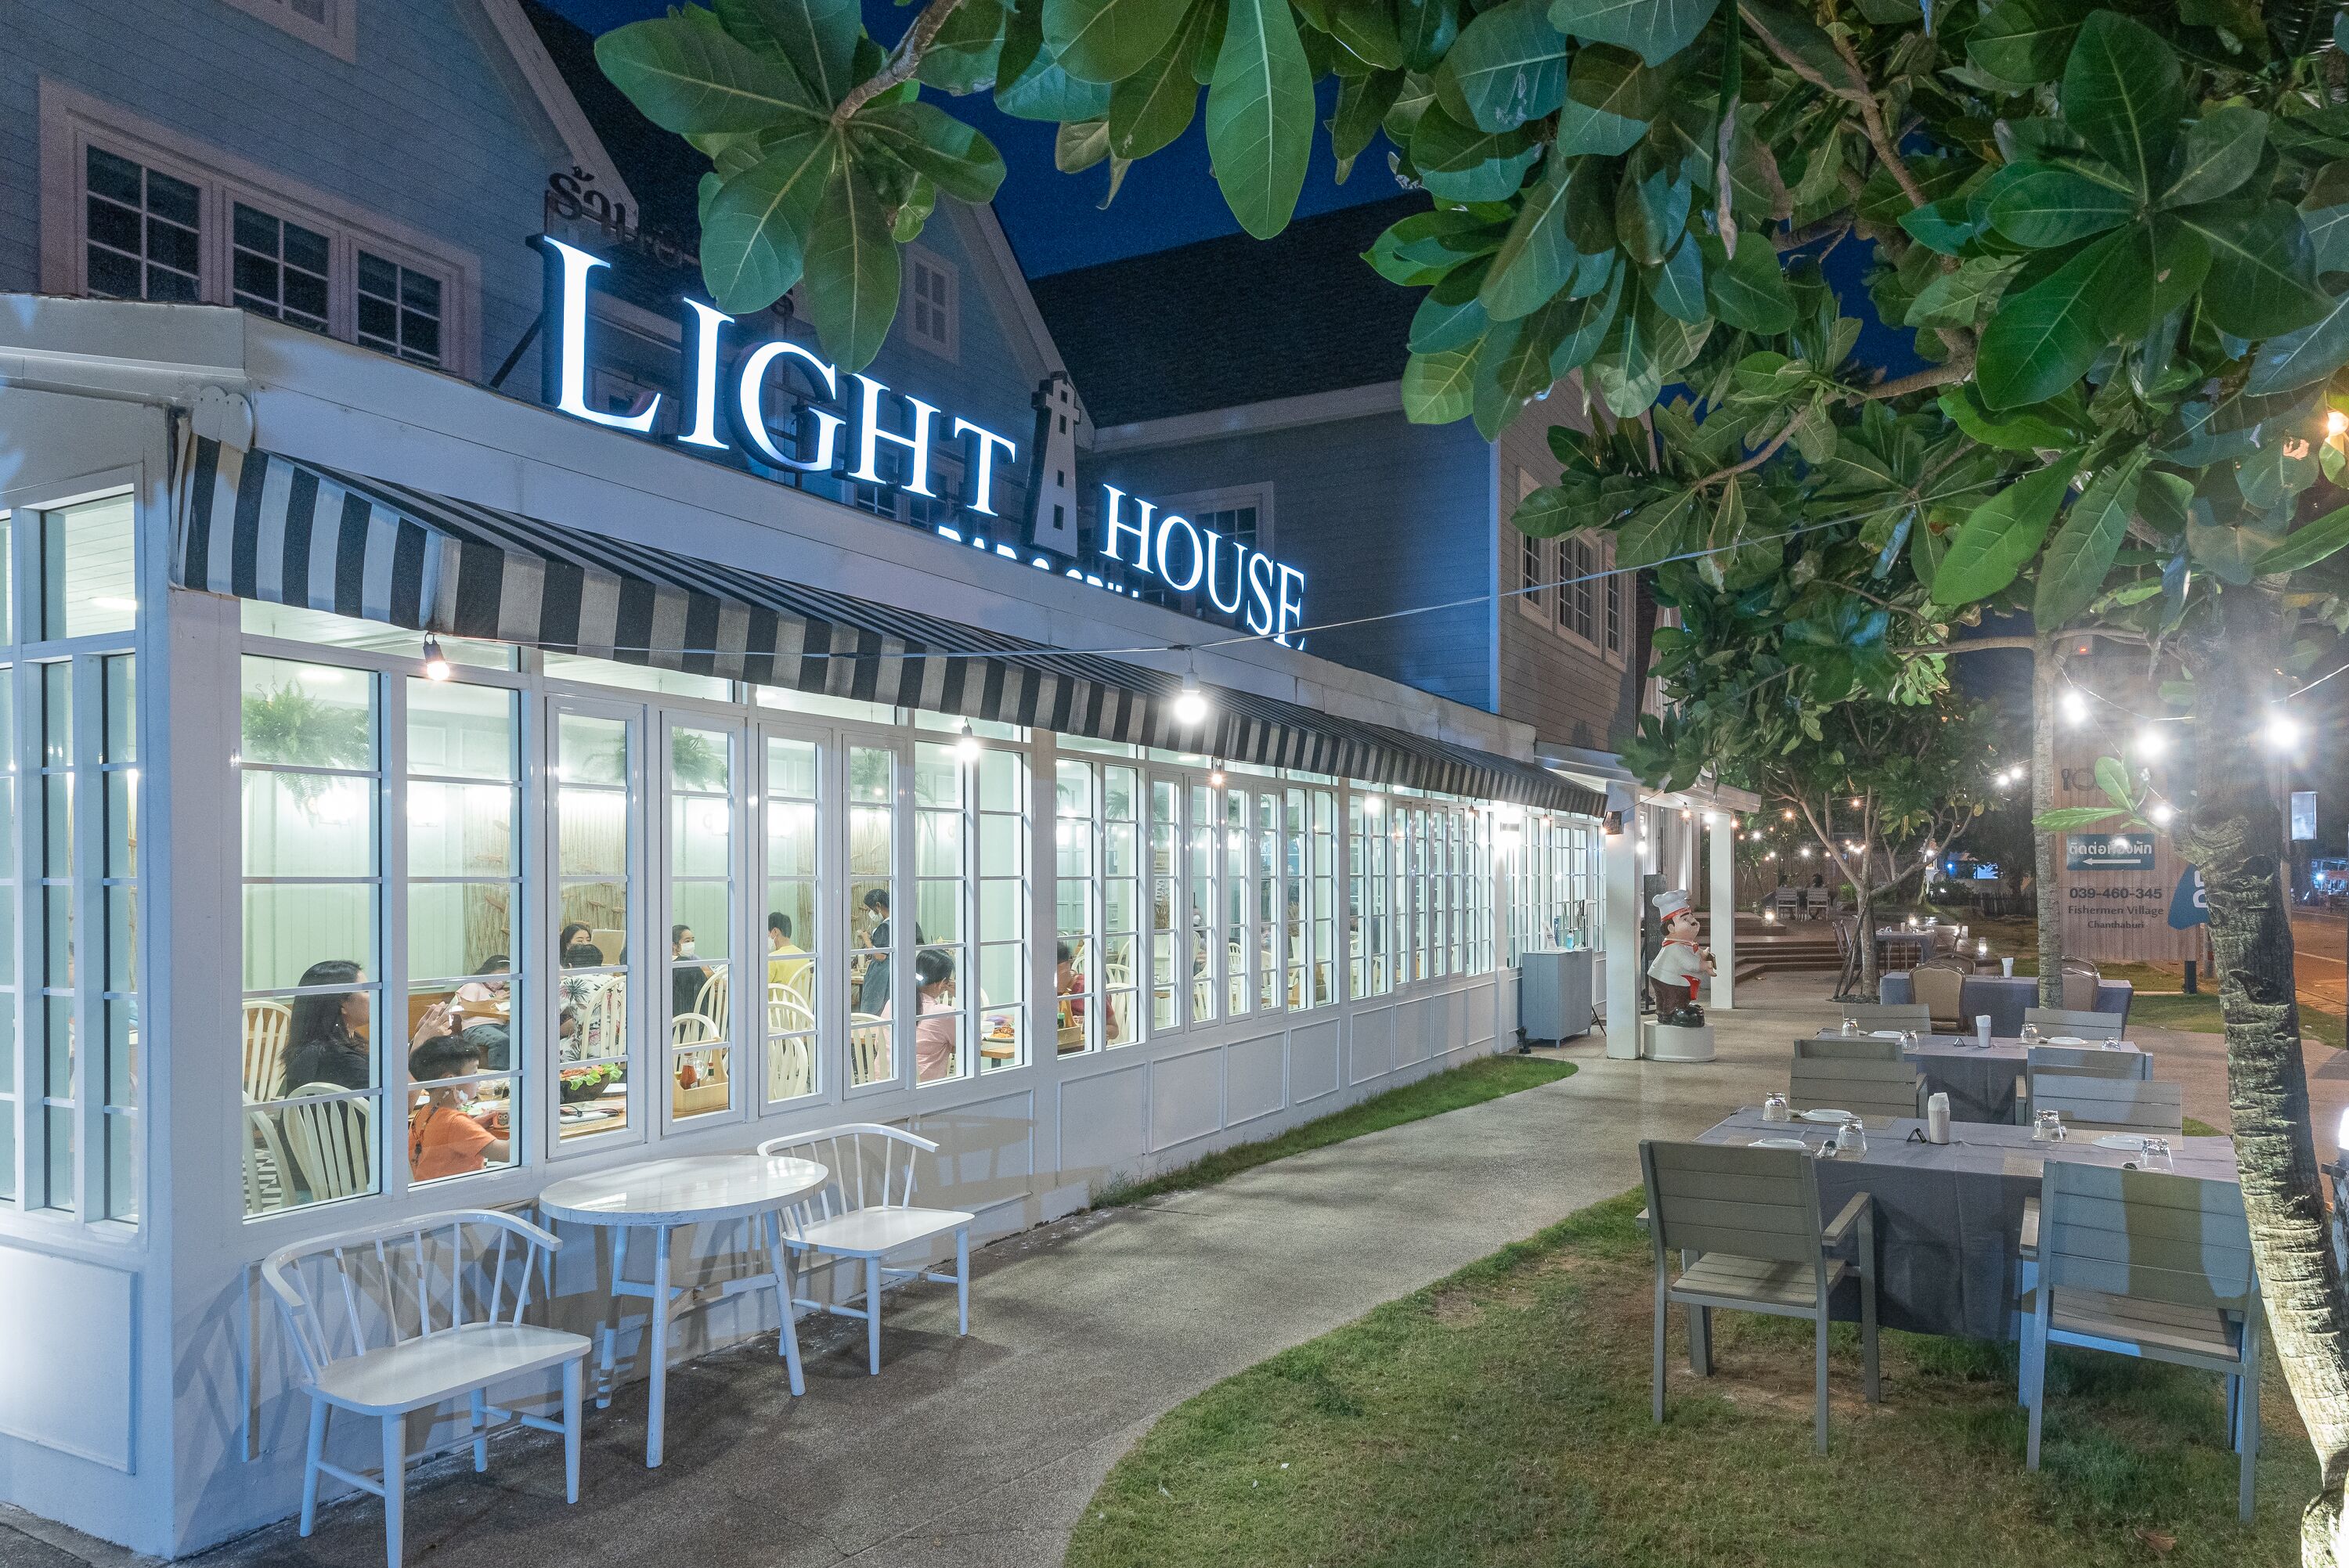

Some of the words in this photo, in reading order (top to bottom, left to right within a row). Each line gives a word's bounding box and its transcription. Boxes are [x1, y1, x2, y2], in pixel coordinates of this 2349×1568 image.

[543, 236, 1016, 517] LIGHT
[1099, 483, 1305, 651] HOUSE
[2069, 887, 2163, 899] 039-460-345
[2068, 905, 2124, 915] Fishermen
[2127, 905, 2164, 917] Village
[2087, 921, 2145, 929] Chanthaburi
